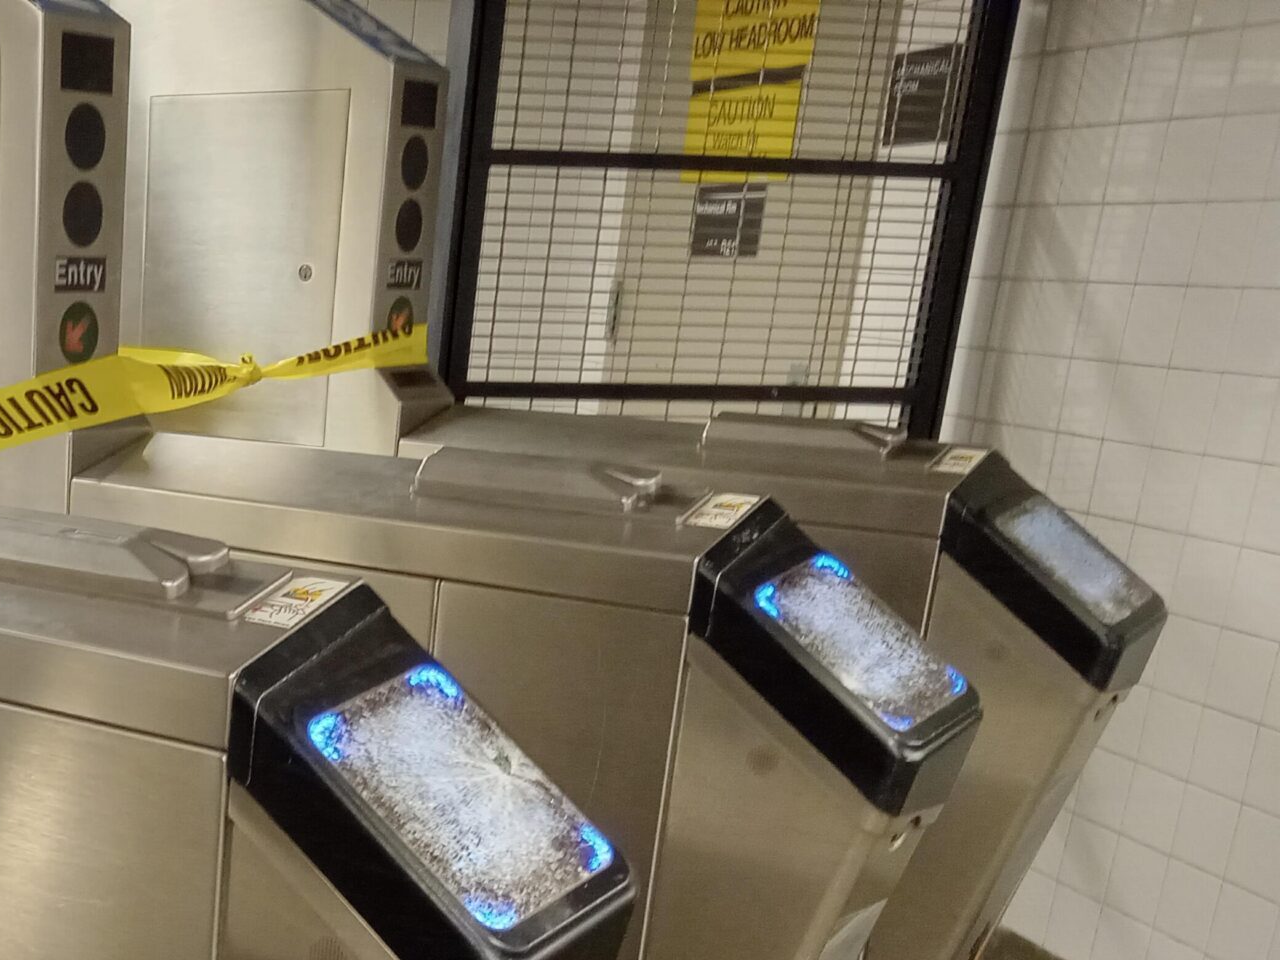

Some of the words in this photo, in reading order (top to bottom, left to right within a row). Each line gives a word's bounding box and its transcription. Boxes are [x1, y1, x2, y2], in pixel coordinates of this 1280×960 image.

[694, 32, 725, 59] LOW
[729, 13, 816, 51] HEADROOM
[708, 93, 775, 128] CAUTION
[55, 259, 103, 292] Entry
[388, 261, 421, 290] Entry
